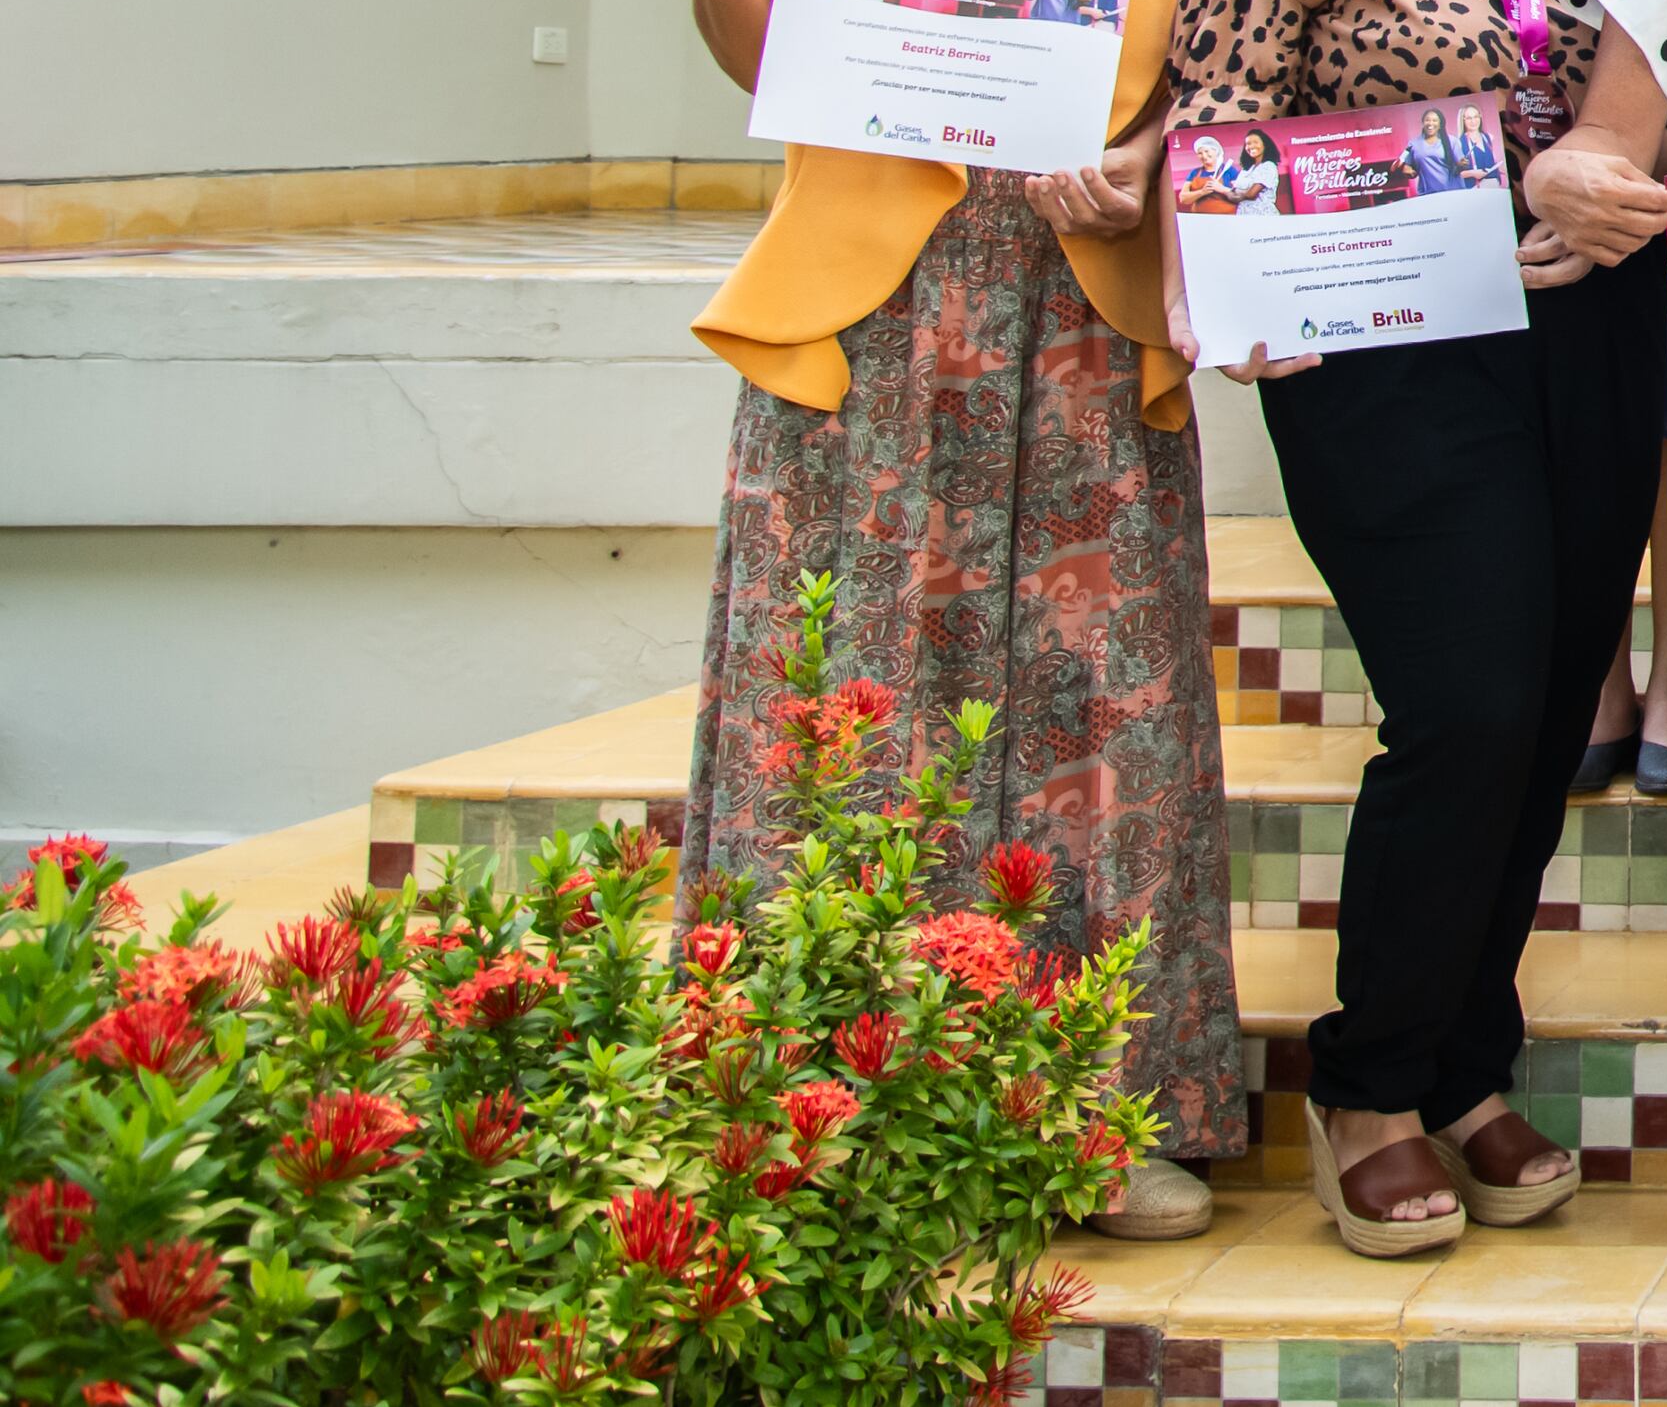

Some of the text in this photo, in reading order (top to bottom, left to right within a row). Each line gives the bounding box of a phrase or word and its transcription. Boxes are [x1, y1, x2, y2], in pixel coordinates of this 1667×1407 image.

[901, 41, 992, 63] Beatriz Barrios
[1515, 91, 1550, 106] Mujeres
[1520, 102, 1563, 115] Brillantes
[894, 123, 923, 134] Gases
[900, 132, 932, 144] Caribe
[942, 126, 996, 147] Brilla
[1315, 147, 1353, 161] Premio
[1294, 155, 1362, 179] Mujeres
[1303, 168, 1388, 195] Brillantes
[1310, 235, 1393, 255] Sissi Contreras
[1326, 319, 1354, 329] Gases
[1372, 308, 1424, 328] Brilla
[1335, 325, 1365, 336] Caribe
